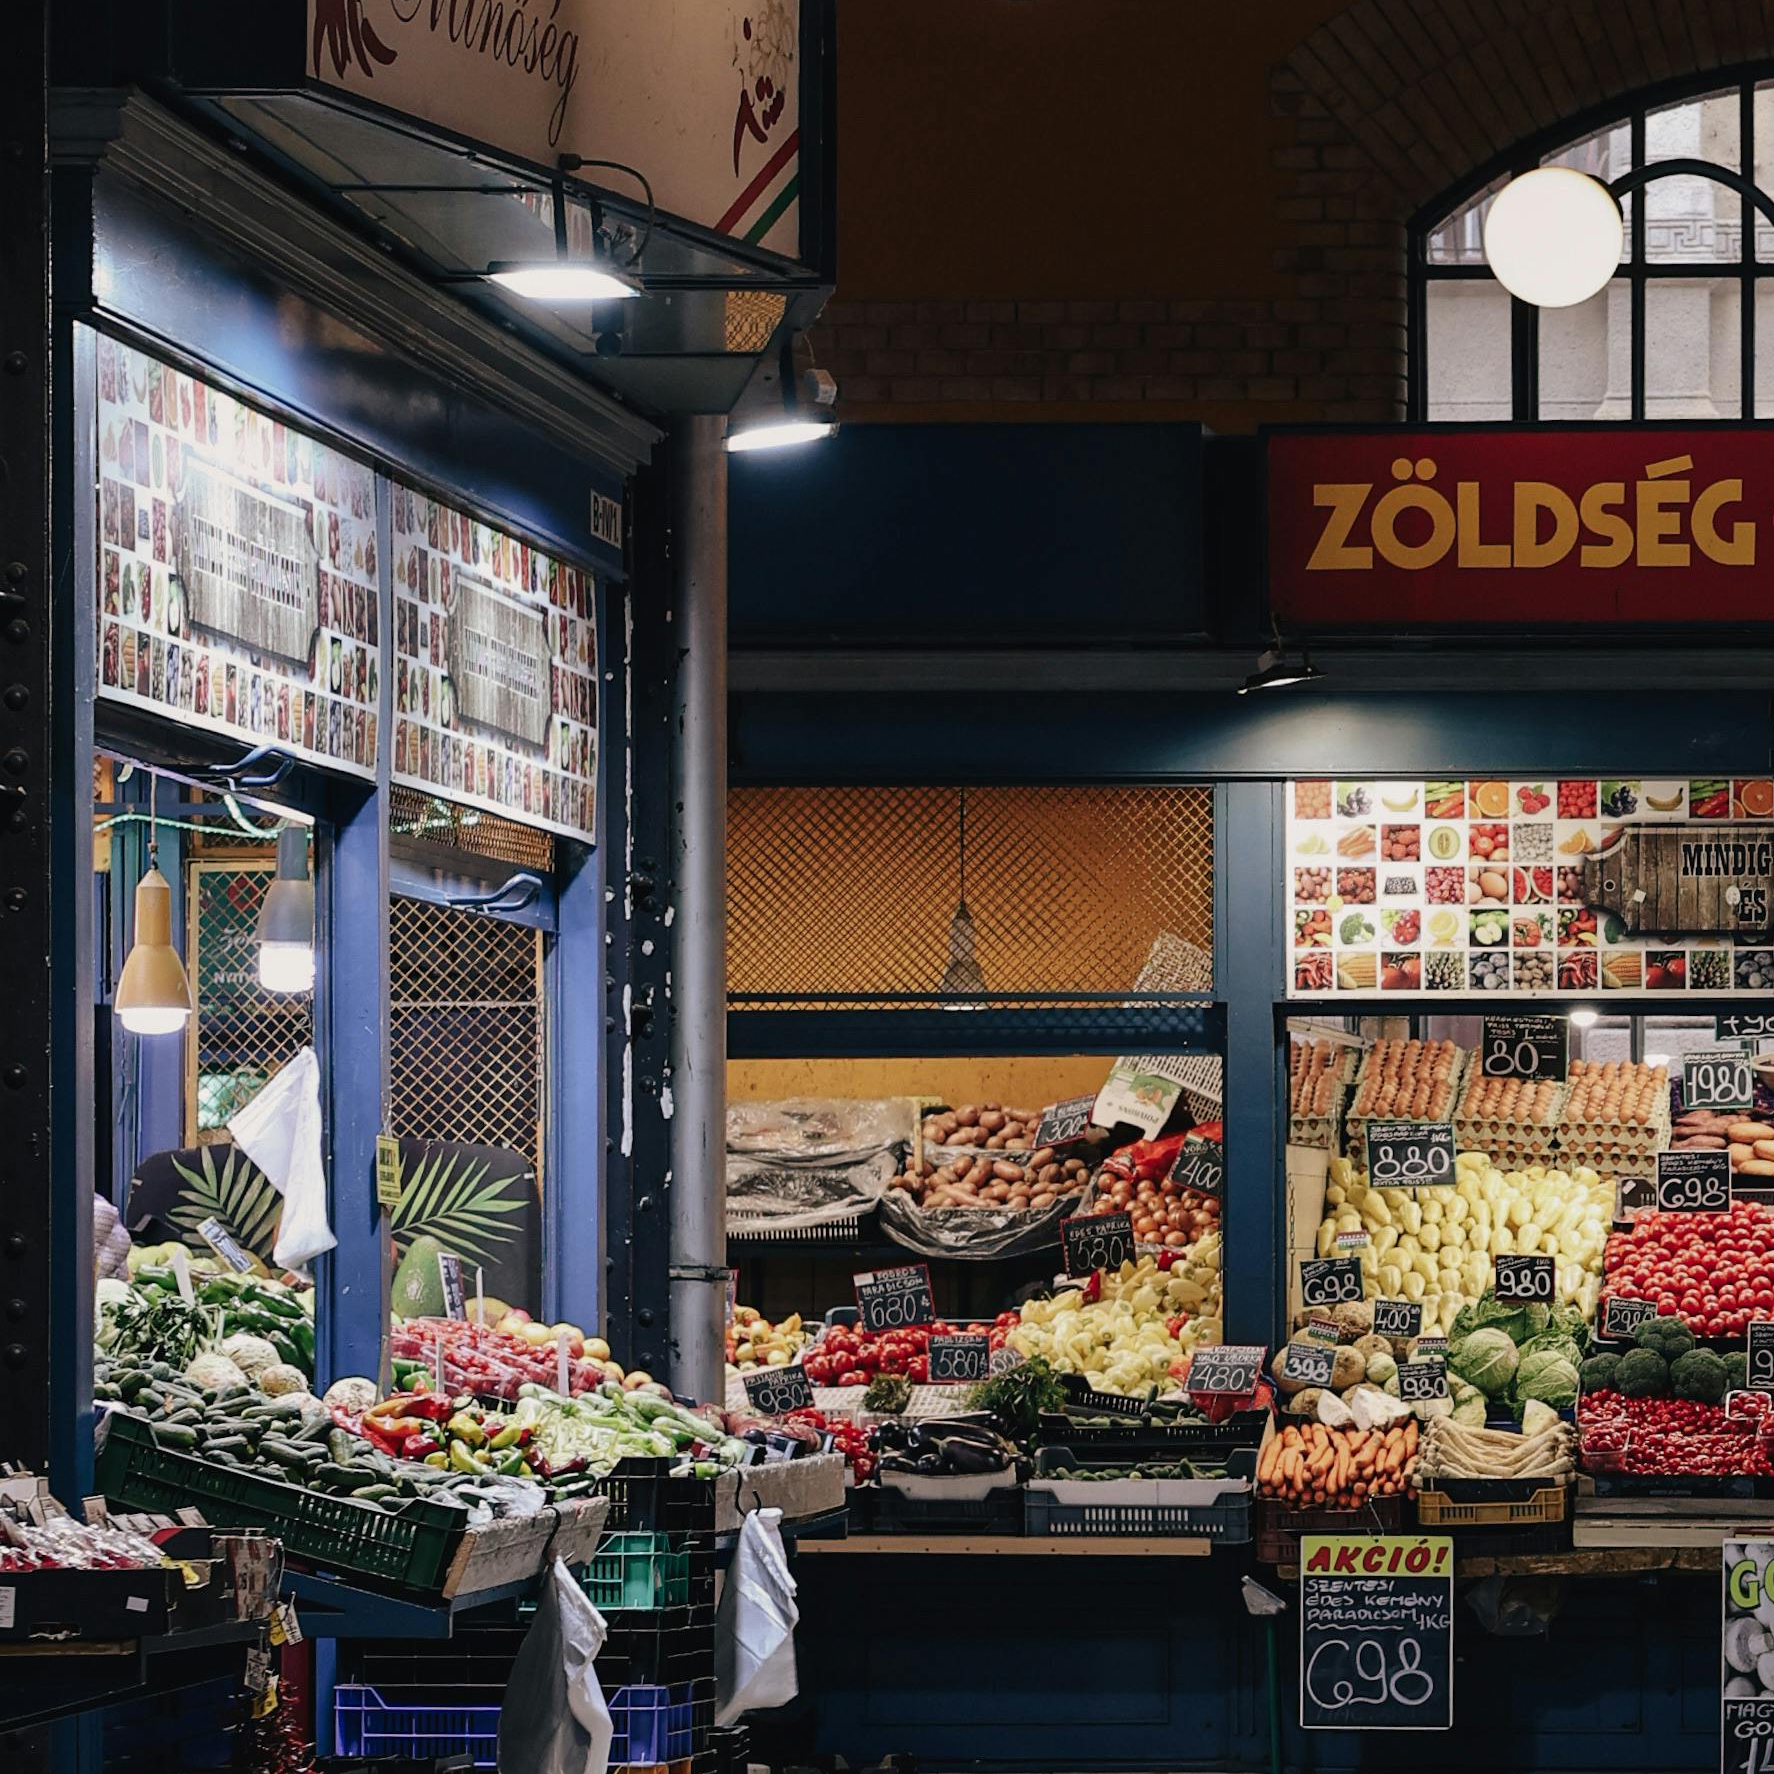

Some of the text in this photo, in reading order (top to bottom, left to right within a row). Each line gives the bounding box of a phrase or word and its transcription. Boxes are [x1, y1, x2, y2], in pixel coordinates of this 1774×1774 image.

[1306, 453, 1758, 571] ZÖLDSÉG
[1682, 842, 1774, 876] MINDIG
[1304, 1273, 1361, 1304] 698
[1496, 1269, 1551, 1297] 980
[870, 1292, 918, 1327] 680
[937, 1348, 979, 1377] 580
[1194, 1364, 1245, 1391] 480
[758, 1383, 803, 1416] 980
[1402, 1376, 1448, 1401] 980
[1306, 1538, 1449, 1574] AKCIÓ!
[1305, 1579, 1395, 1593] SZENTESI
[1306, 1607, 1418, 1622] PARADICSOM
[1306, 1638, 1434, 1709] 698
